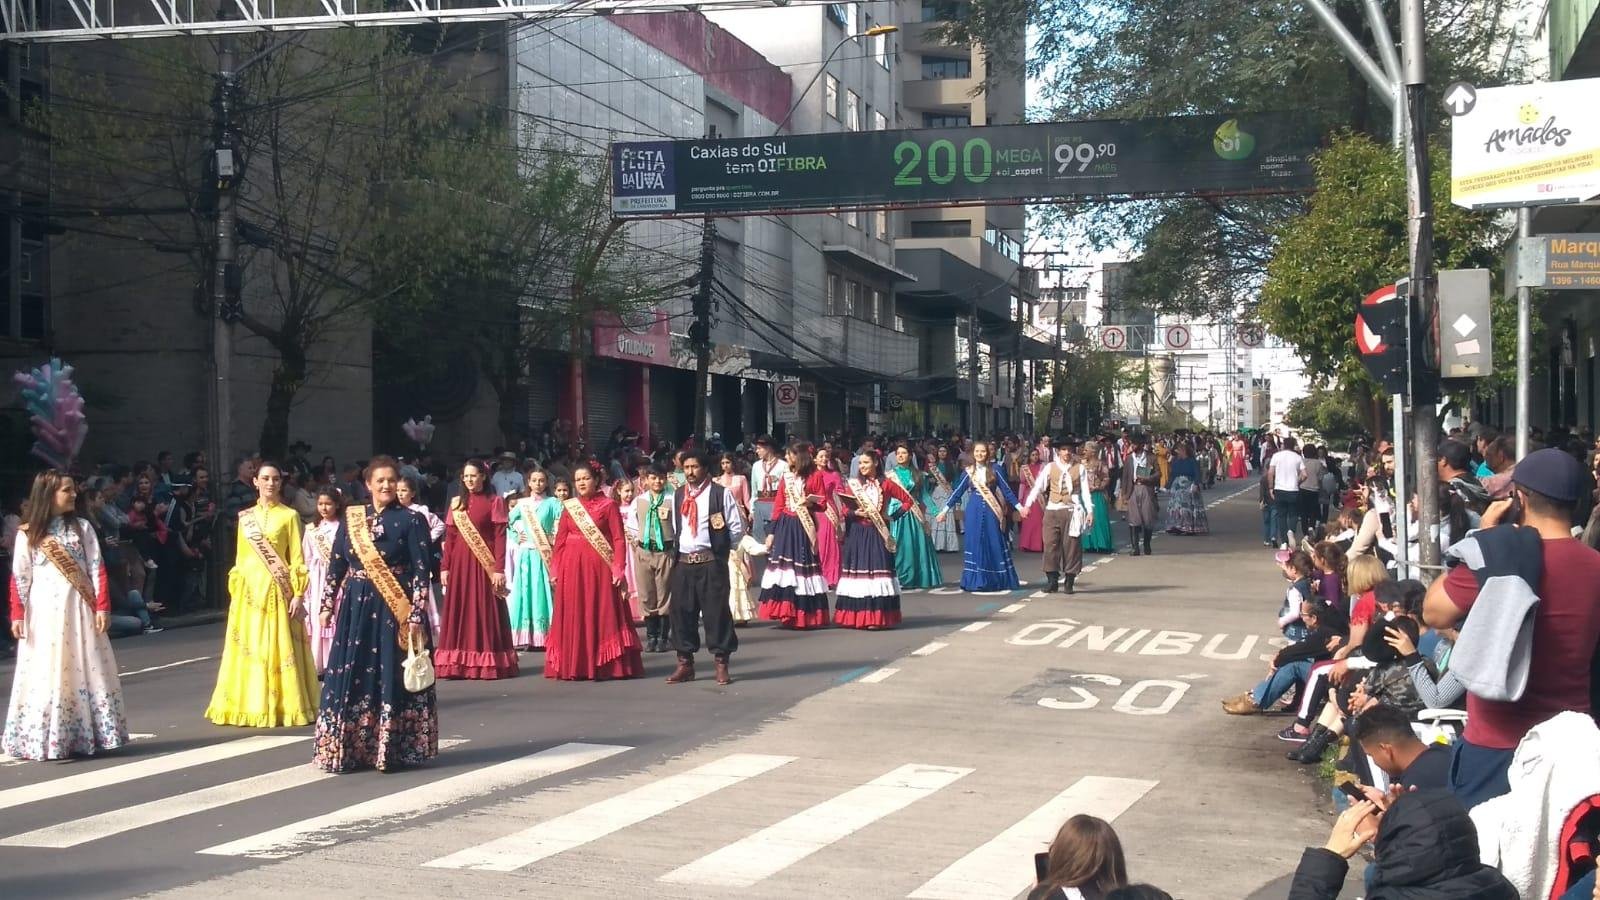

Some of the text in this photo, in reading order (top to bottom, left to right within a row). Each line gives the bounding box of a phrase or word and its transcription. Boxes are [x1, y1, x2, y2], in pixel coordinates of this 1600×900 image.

[1484, 115, 1572, 153] Amados
[690, 142, 787, 159] Caxias do Sul
[996, 149, 1043, 163] MEGA
[621, 148, 666, 171] FESTA
[725, 162, 755, 174] tem
[894, 137, 992, 186] 200
[622, 171, 665, 190] DA UVA
[1551, 239, 1600, 256] Marq
[1551, 260, 1600, 270] Rua Marqu
[1552, 276, 1572, 285] 1396
[1037, 673, 1209, 715] SÓ
